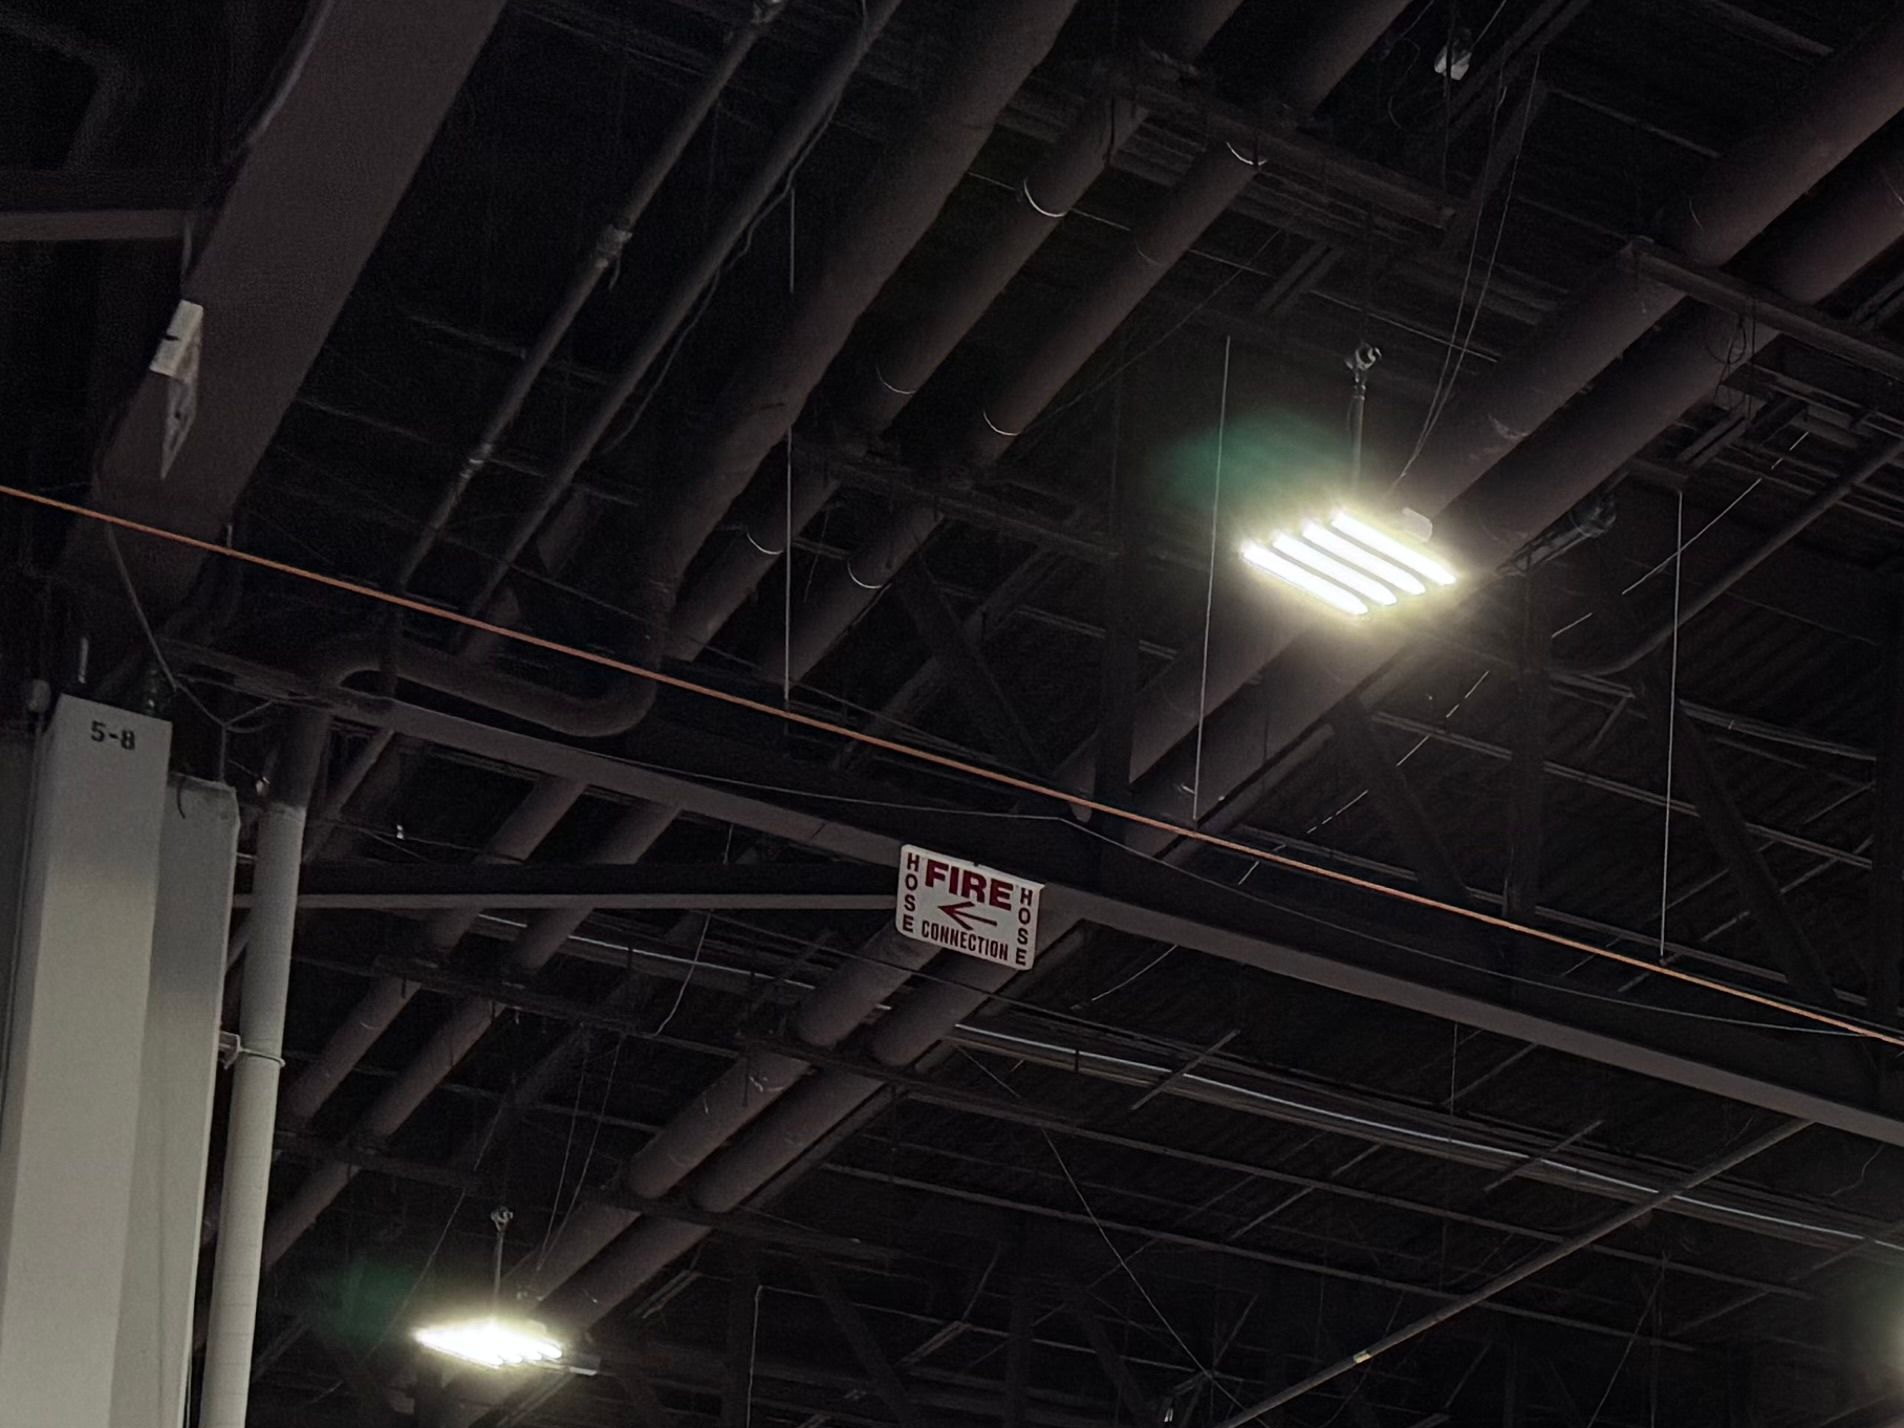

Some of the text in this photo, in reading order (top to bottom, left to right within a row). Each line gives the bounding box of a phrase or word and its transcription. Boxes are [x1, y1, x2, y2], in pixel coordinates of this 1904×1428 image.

[90, 719, 136, 751] 5-8
[902, 852, 920, 933] HOSE
[925, 858, 1014, 912] FIRE
[921, 919, 1009, 961] CONNECTION
[1015, 887, 1033, 966] HOSE
